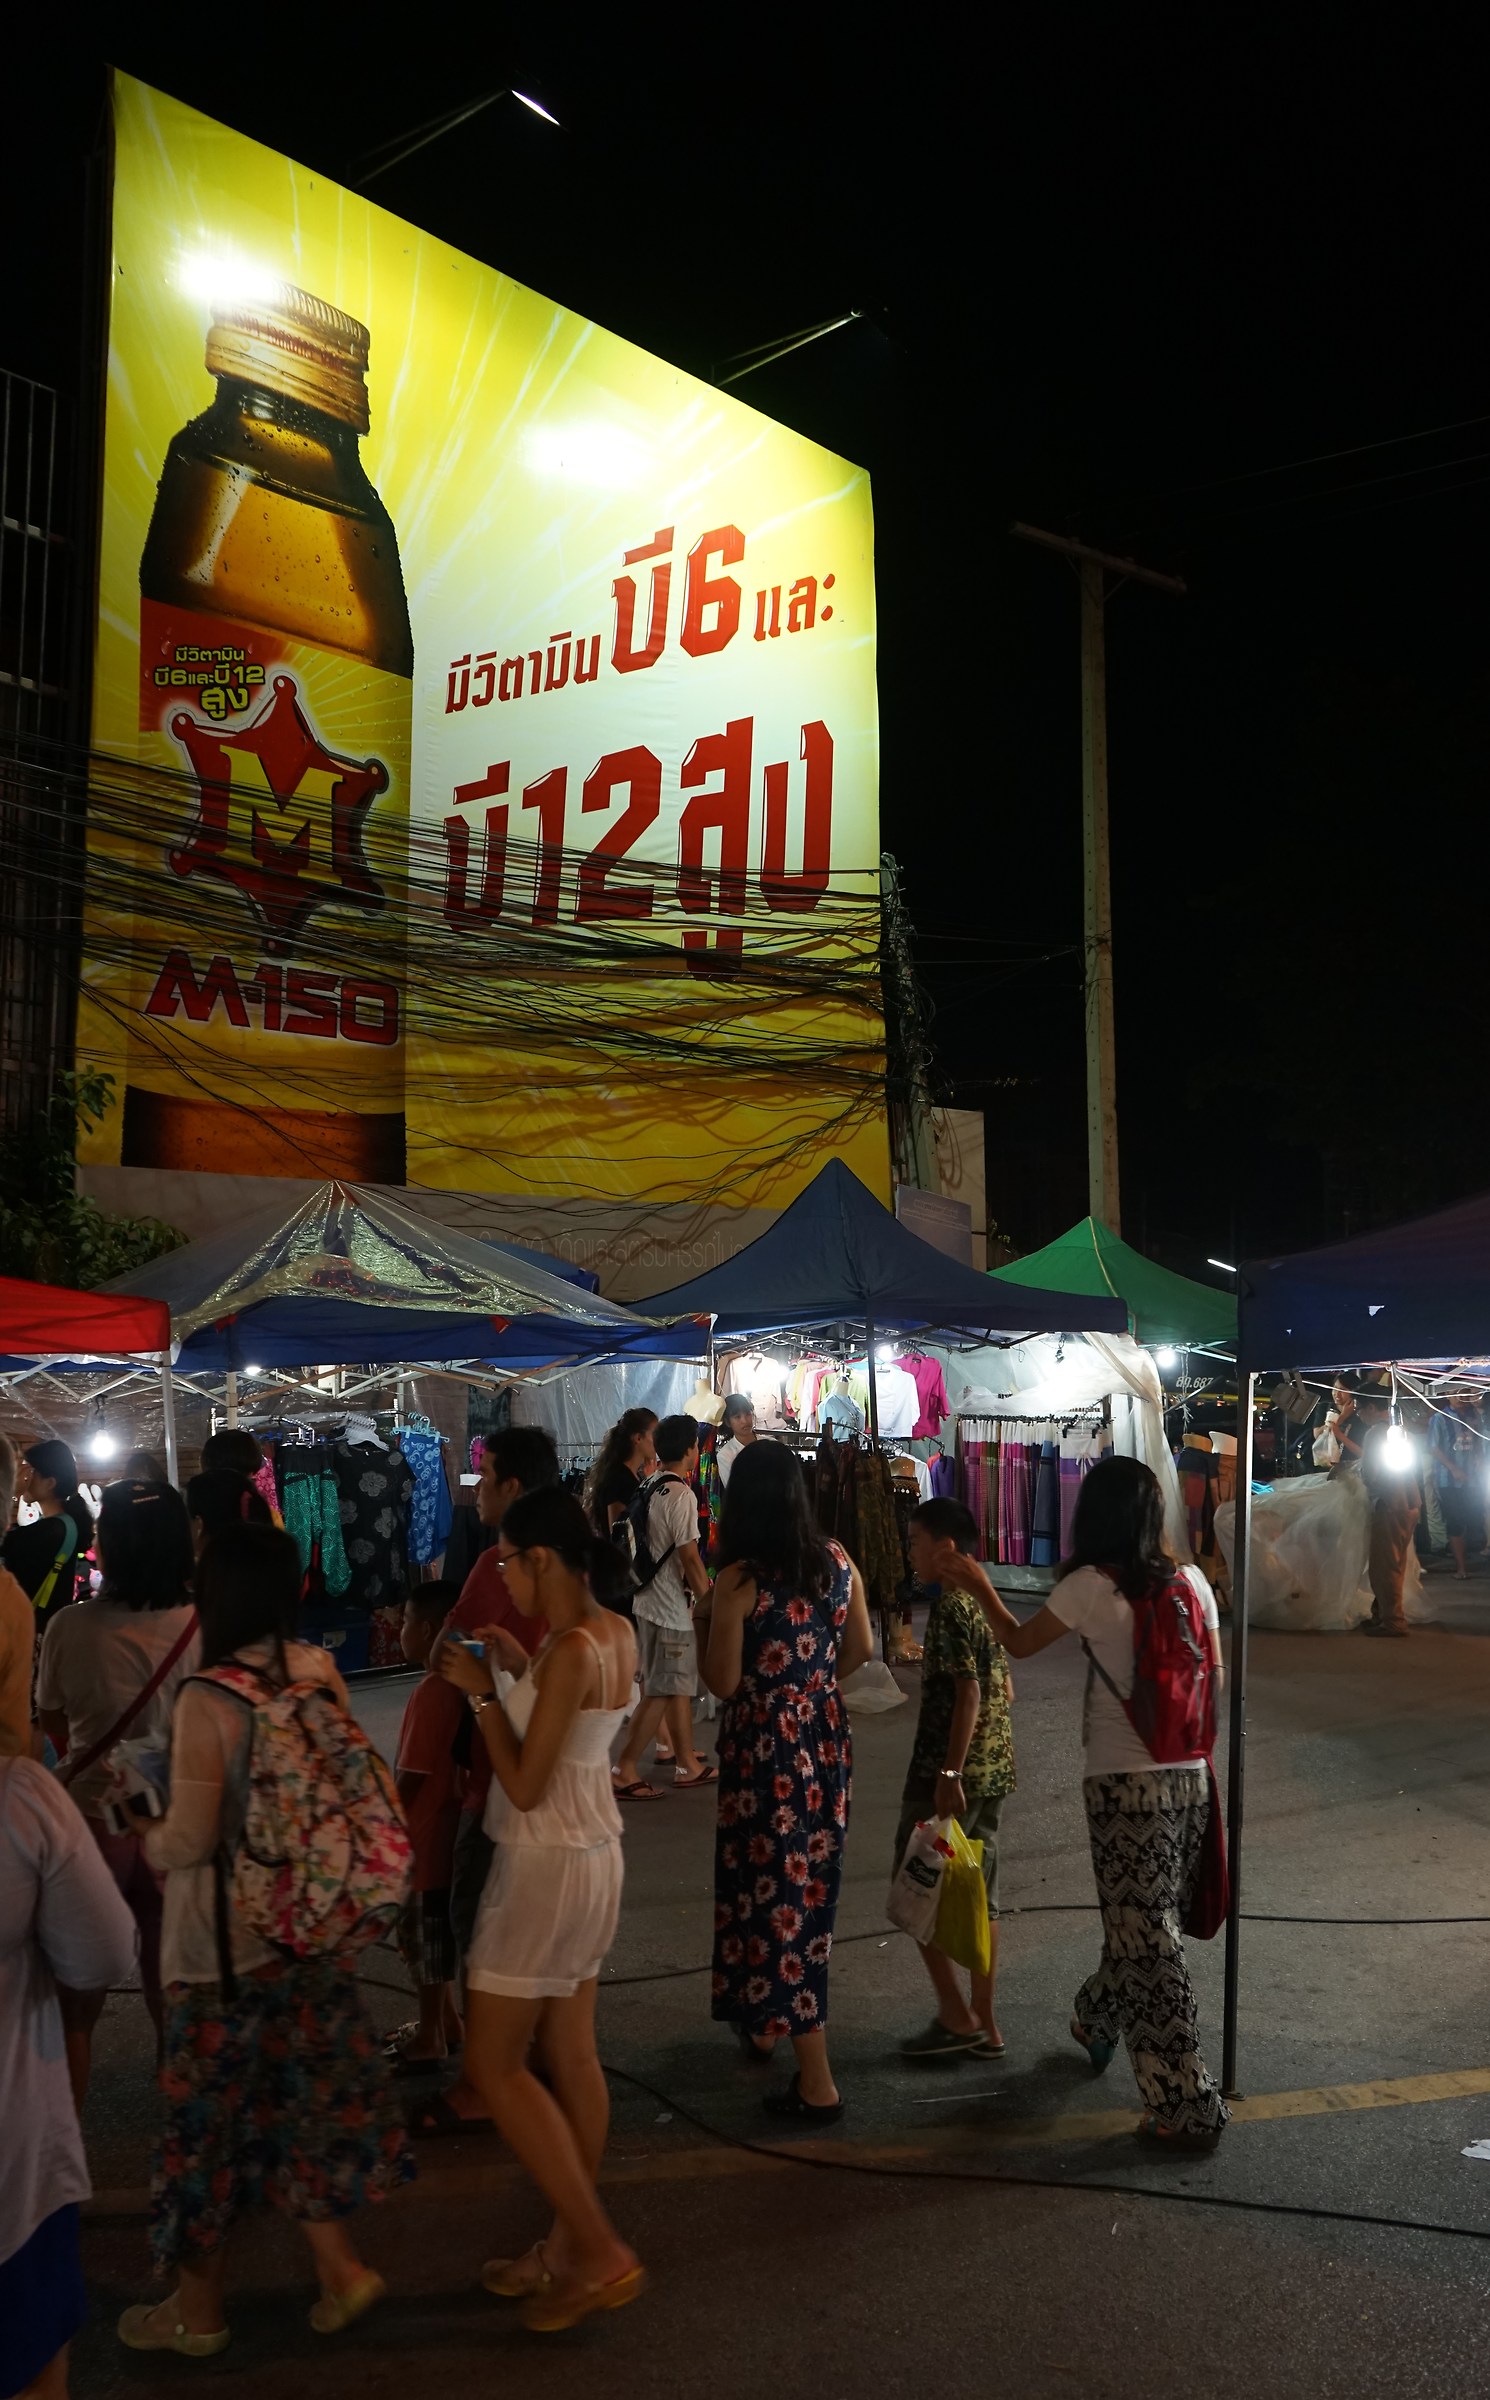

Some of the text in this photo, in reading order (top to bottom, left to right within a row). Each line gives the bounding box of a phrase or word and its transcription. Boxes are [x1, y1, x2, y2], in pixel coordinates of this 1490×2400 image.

[175, 646, 245, 663] มีวิตามิน
[445, 524, 836, 714] มีวิตามิน บี6 และ
[201, 686, 249, 719] สูง
[214, 744, 344, 885] M
[144, 949, 399, 1046] M-150
